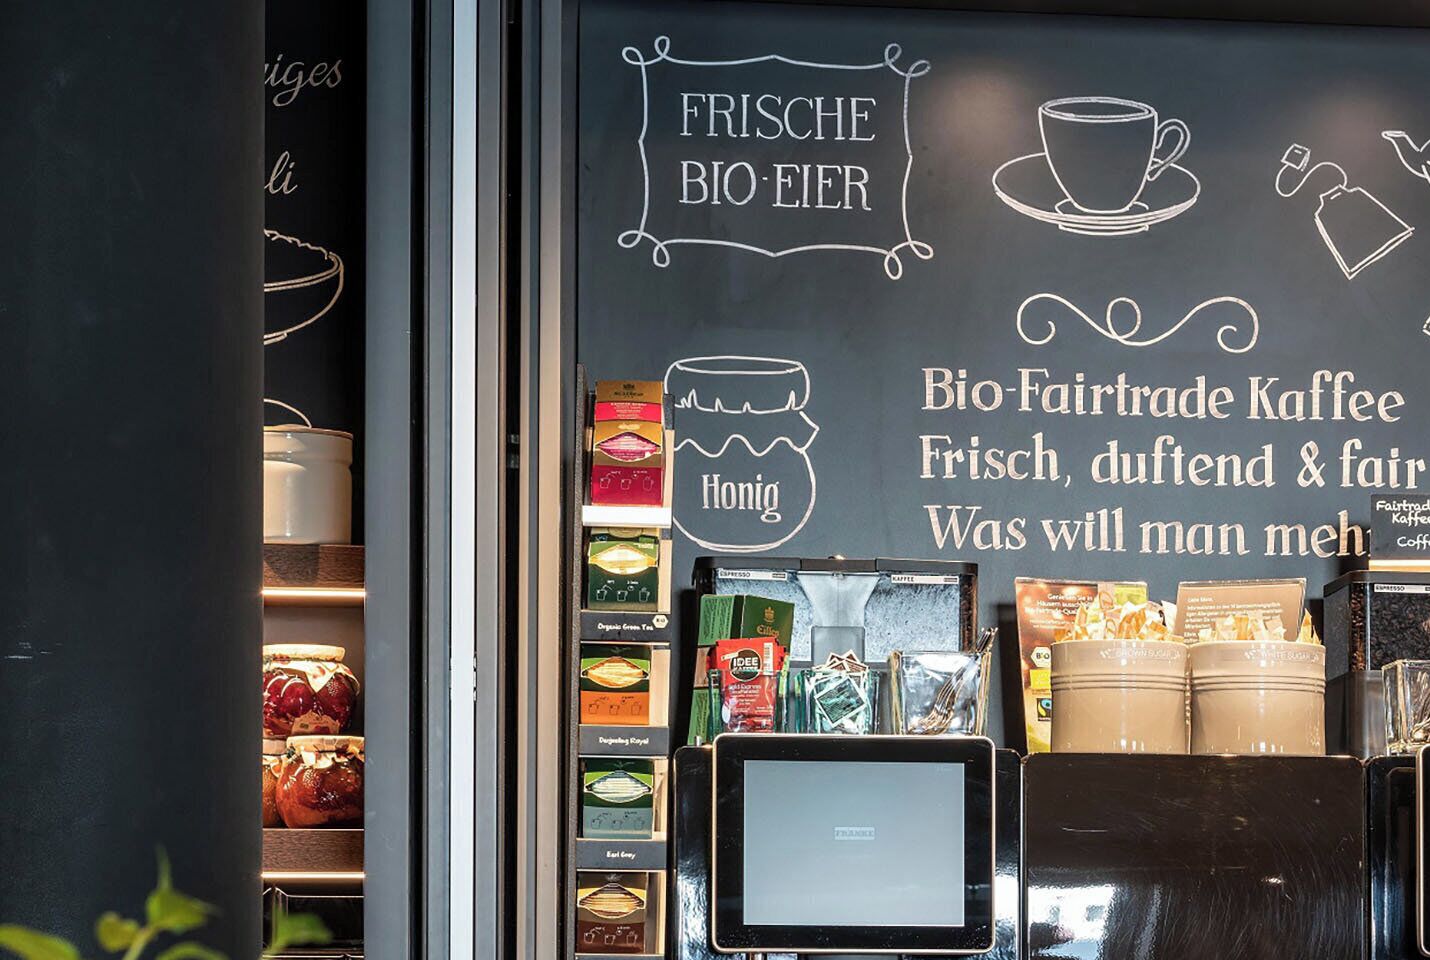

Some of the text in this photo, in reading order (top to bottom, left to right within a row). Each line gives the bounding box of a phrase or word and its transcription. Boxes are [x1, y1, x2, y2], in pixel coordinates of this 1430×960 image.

[264, 54, 342, 107] iges
[679, 92, 877, 144] FRISCHE
[679, 160, 872, 211] BIO-EIER
[920, 366, 1406, 423] Bio-Fairtrade Kaffee
[918, 432, 1427, 490] Frisch, duftend & fair
[702, 473, 781, 524] Honig
[922, 503, 1028, 551] Was
[1040, 507, 1127, 554] will
[1138, 519, 1247, 556] man
[733, 657, 759, 666] IDEE
